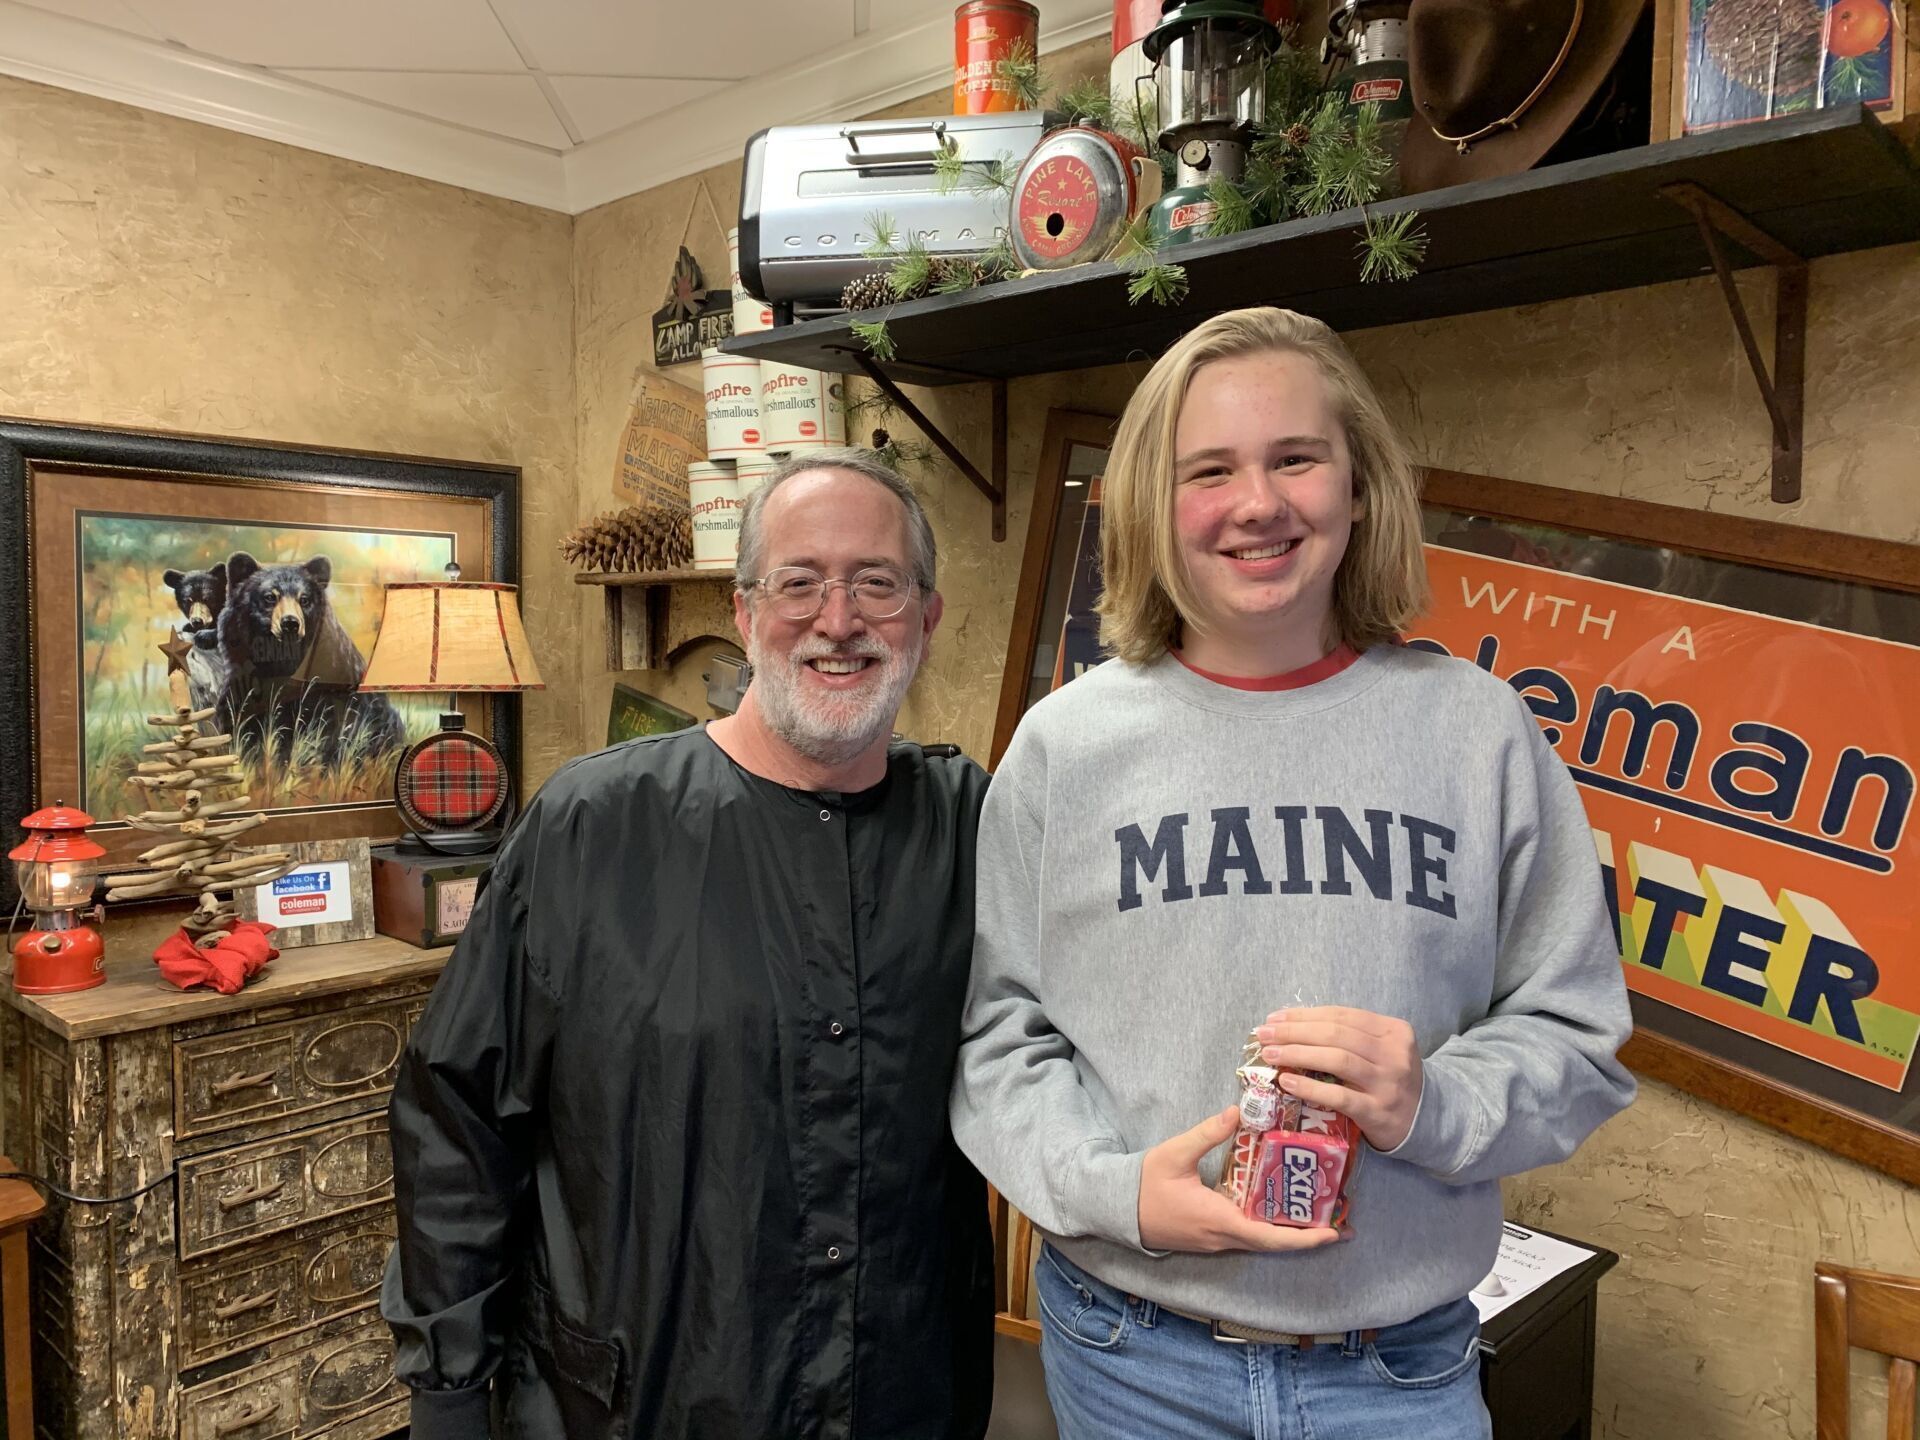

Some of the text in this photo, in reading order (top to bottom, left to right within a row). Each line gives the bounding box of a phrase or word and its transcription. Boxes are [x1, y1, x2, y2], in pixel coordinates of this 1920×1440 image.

[1356, 84, 1391, 99] Coleman
[1025, 160, 1097, 202] PINE LAKE
[656, 322, 693, 354] CAMP
[671, 337, 721, 362] ALLOWE
[626, 428, 704, 480] MATCH
[693, 518, 740, 532] Marshmallo
[1460, 576, 1697, 660] WITH A
[619, 706, 657, 736] FIRE
[1114, 805, 1457, 920] MAINE
[275, 883, 316, 894] facebook
[292, 876, 303, 884] Us
[303, 875, 315, 883] On
[281, 898, 325, 910] coleman
[1284, 1147, 1319, 1223] Extra
